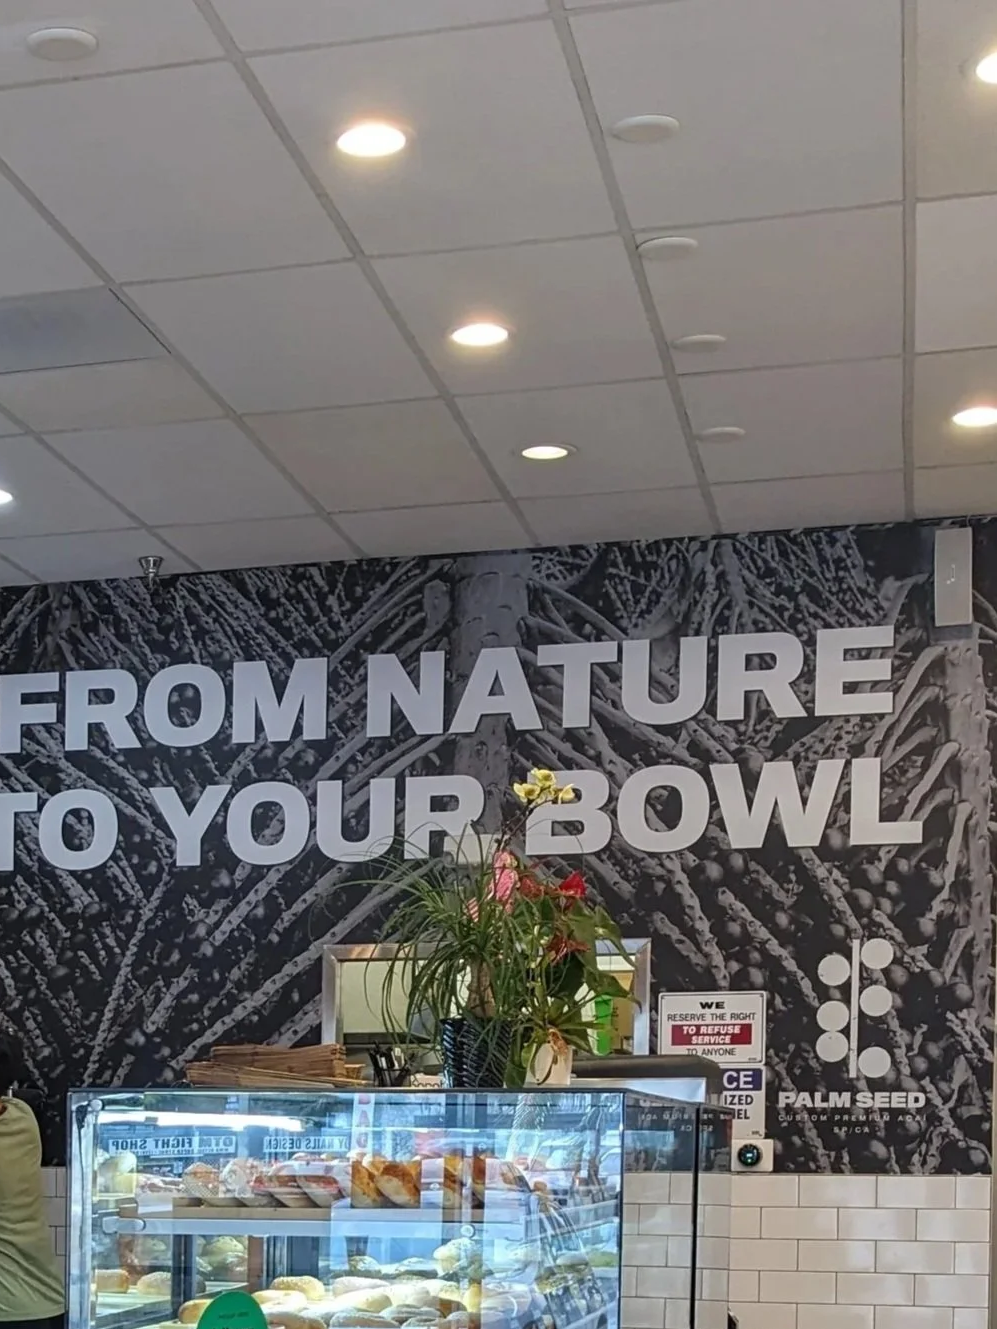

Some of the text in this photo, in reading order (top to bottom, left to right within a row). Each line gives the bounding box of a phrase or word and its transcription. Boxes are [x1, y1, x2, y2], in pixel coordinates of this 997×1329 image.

[366, 625, 895, 738] NATURE
[149, 774, 486, 867] YOUR
[525, 757, 923, 856] BOWL
[699, 1001, 725, 1010] WE
[667, 1012, 756, 1022] RESERVE THE RIGHT
[682, 1025, 741, 1034] TO REFUSE
[691, 1035, 731, 1044] SERVICE
[686, 1048, 736, 1056] TO ANYONE
[778, 1091, 926, 1108] PALM SEED
